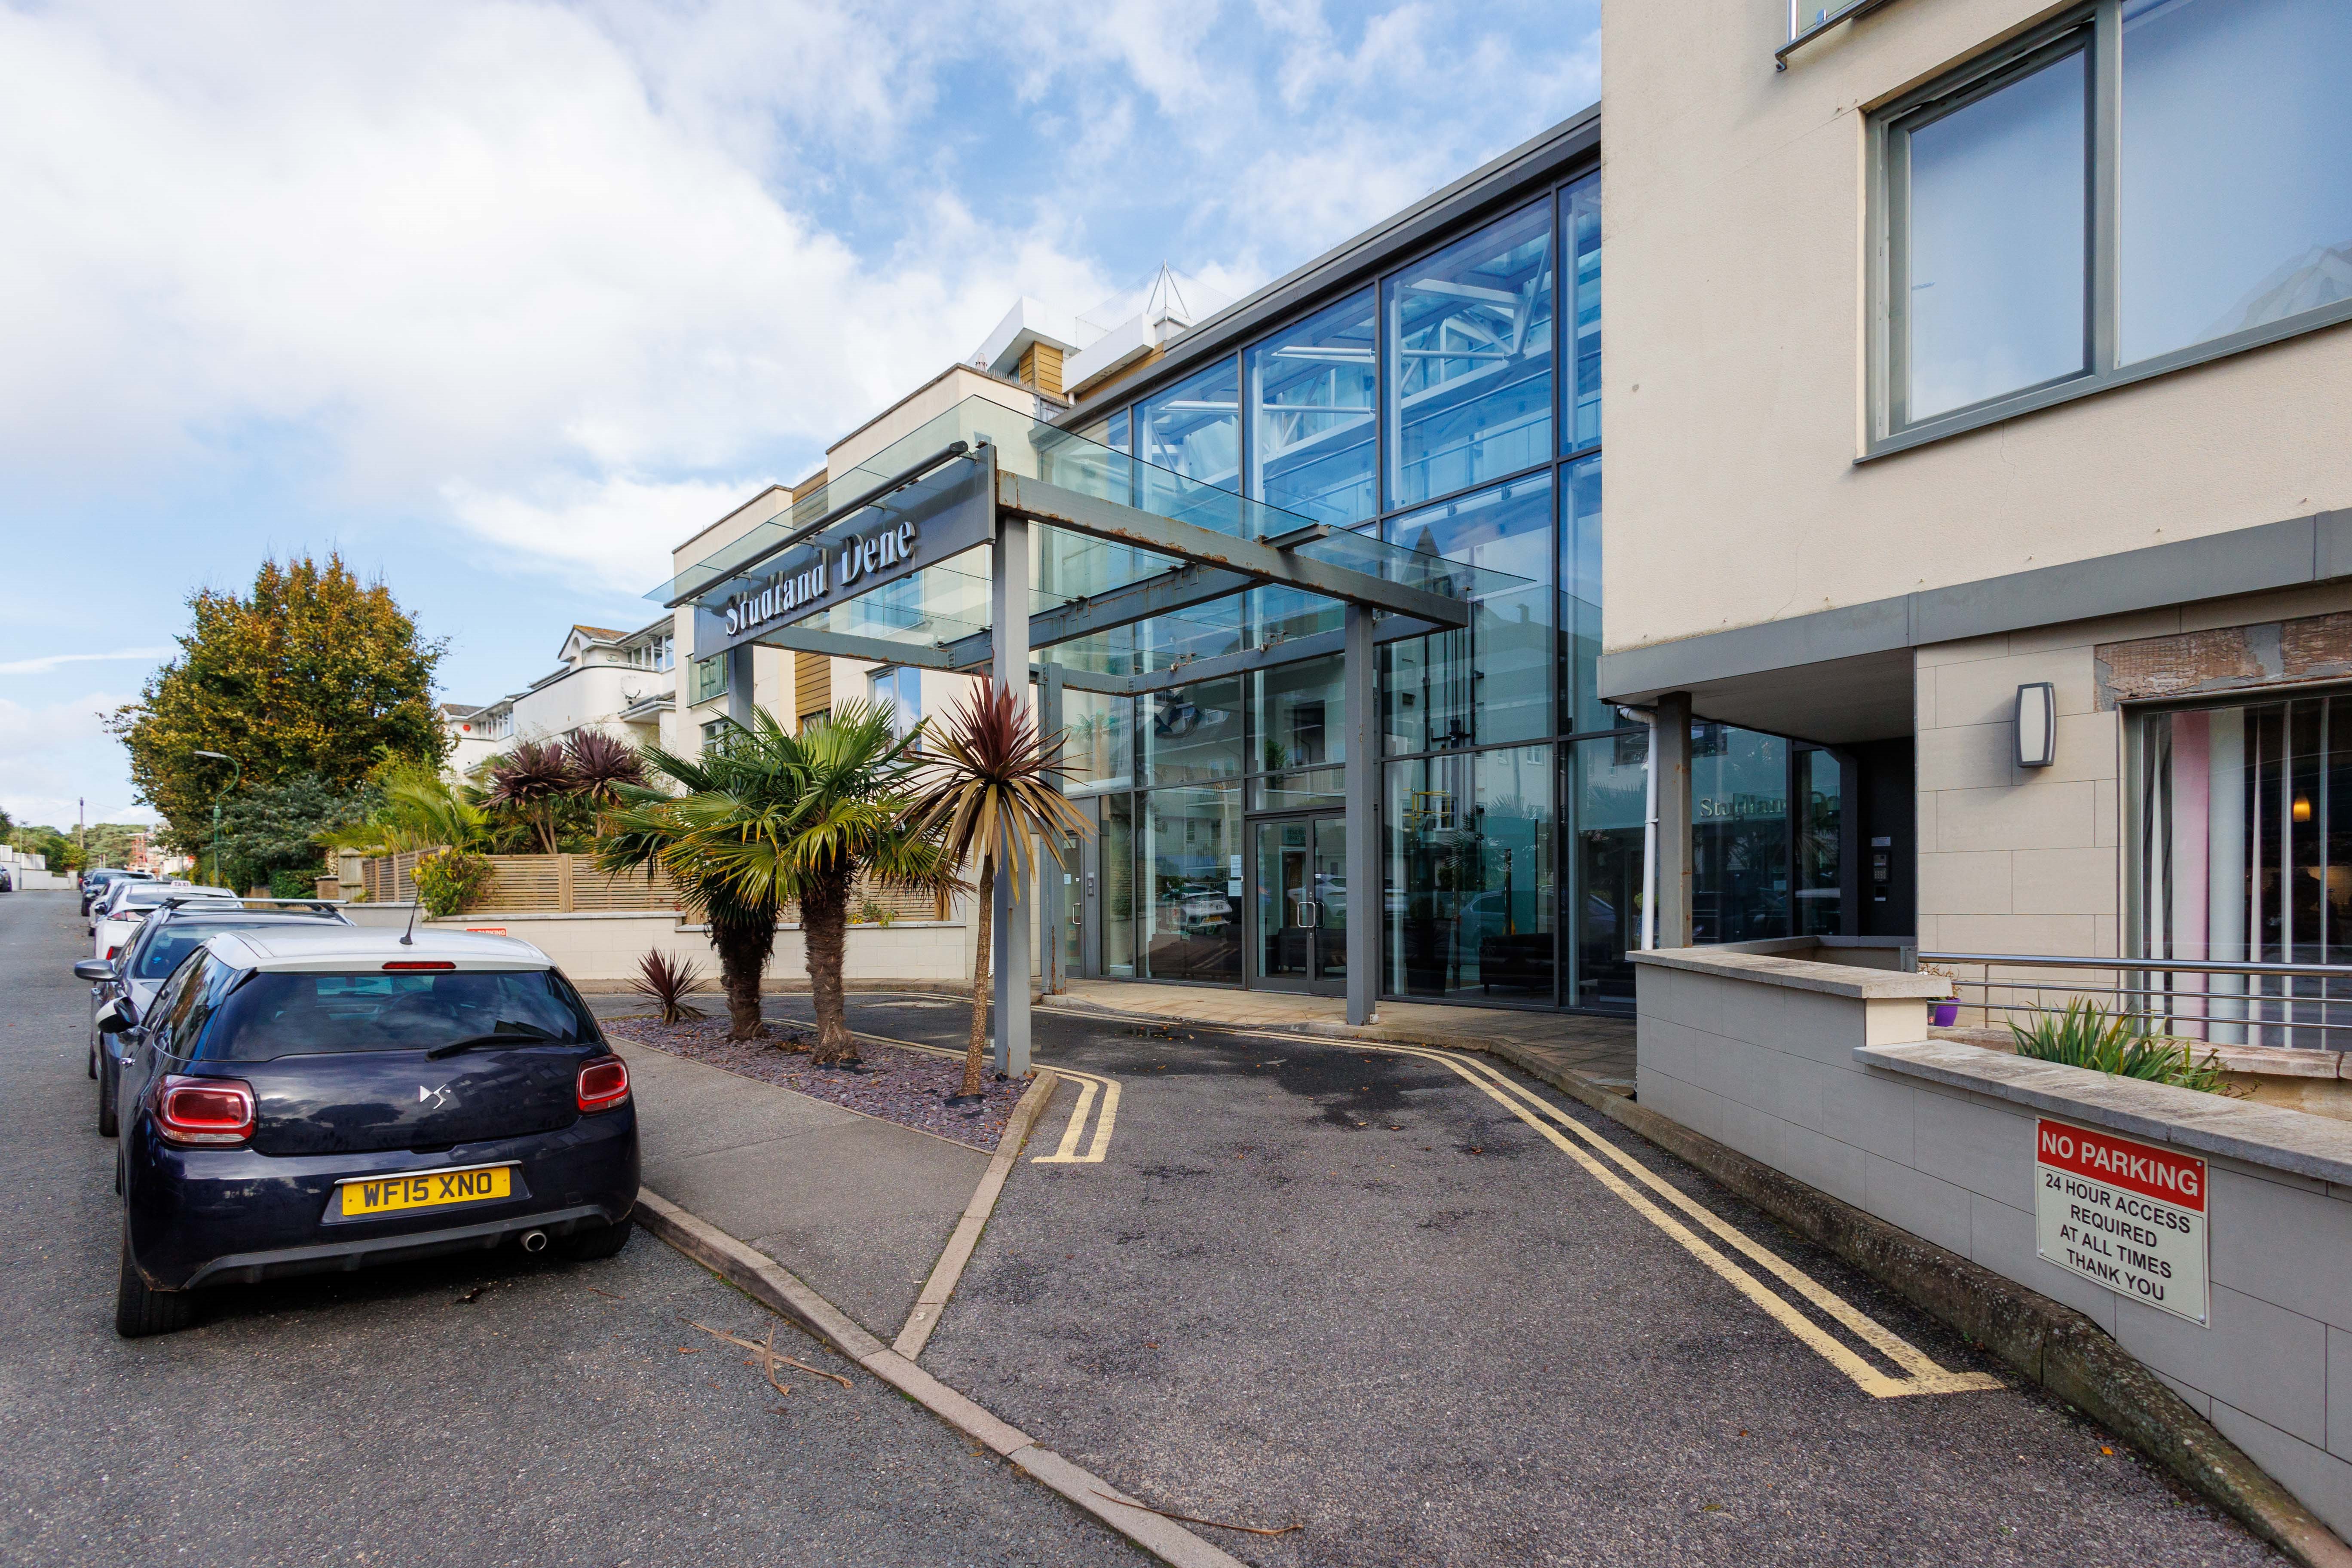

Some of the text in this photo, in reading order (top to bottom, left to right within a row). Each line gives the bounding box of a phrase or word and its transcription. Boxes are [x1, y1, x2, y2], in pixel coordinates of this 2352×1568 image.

[726, 521, 916, 636] Studland Dene
[1700, 795, 1786, 817] Studlan
[363, 1172, 492, 1207] WF15 XNO
[2042, 1130, 2198, 1197] NO PARKING
[2046, 1173, 2190, 1234] 24 HOUR ACCESS
[2071, 1204, 2157, 1248] REQUIRED
[2060, 1224, 2172, 1279] AT ALL TIMES
[2066, 1248, 2164, 1301] THANK YOU
